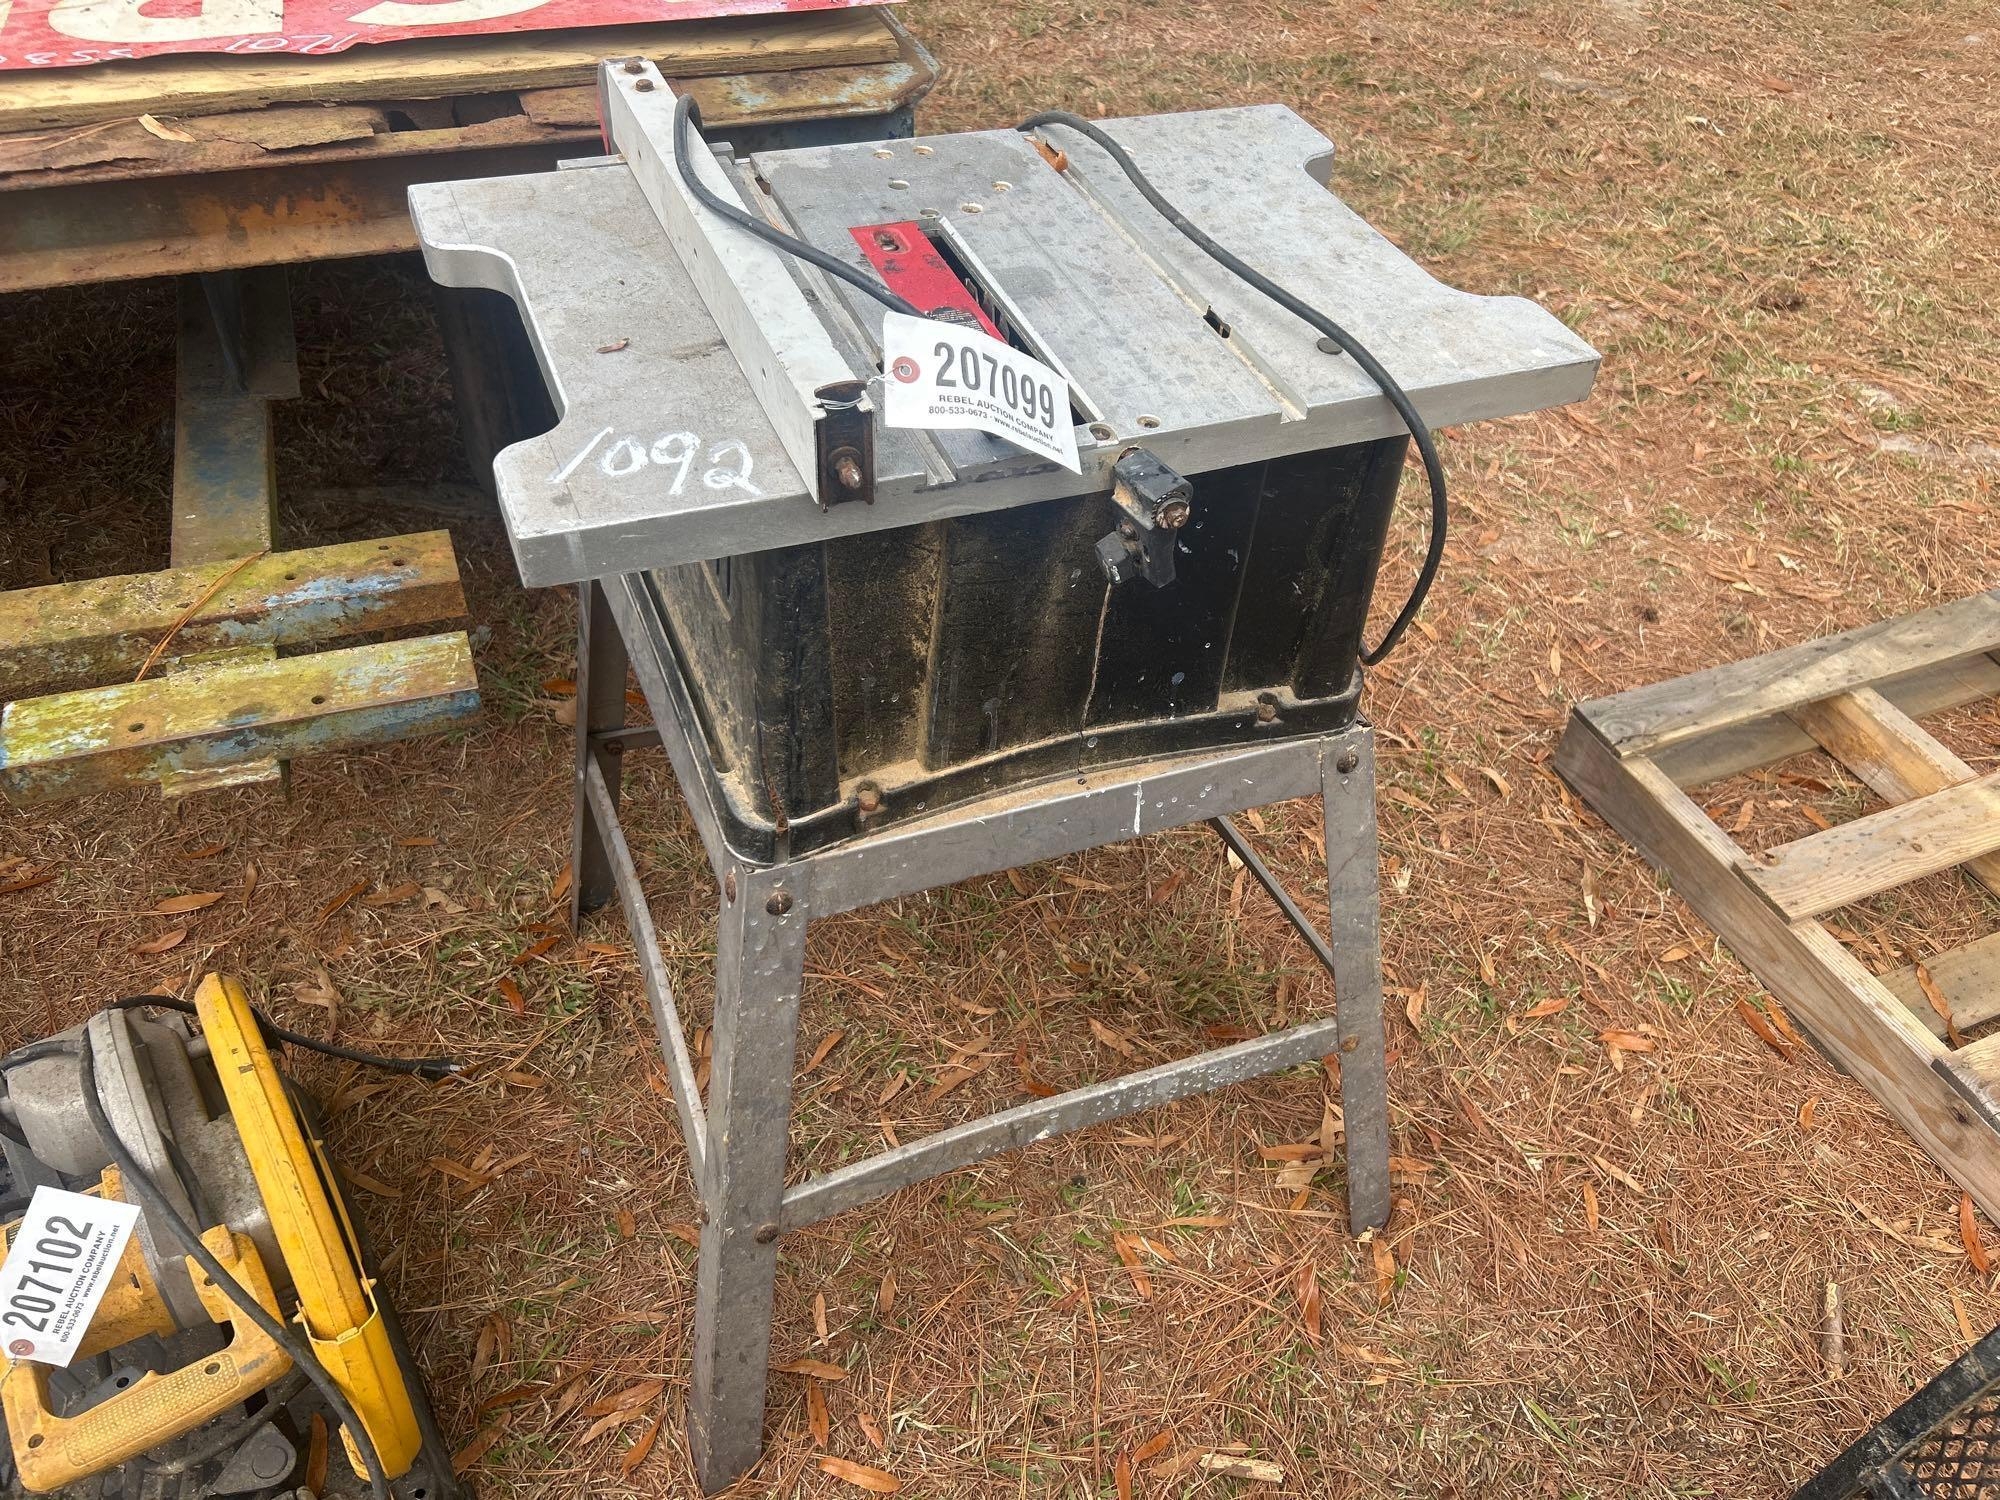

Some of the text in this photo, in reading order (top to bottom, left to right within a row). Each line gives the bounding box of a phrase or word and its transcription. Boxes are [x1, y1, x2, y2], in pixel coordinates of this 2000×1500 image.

[933, 341, 1055, 429] 207099
[938, 394, 1053, 441] REBEL AUCTION COMPANY
[545, 426, 764, 496] 1092
[928, 405, 1064, 455] 800-533-0673 www.rebelauction.net
[2, 1215, 94, 1333] 207102
[52, 1230, 107, 1335] REBEL AUCTION COMPANY
[60, 1224, 121, 1343] 800-533-0673 www.rebelauction.net
